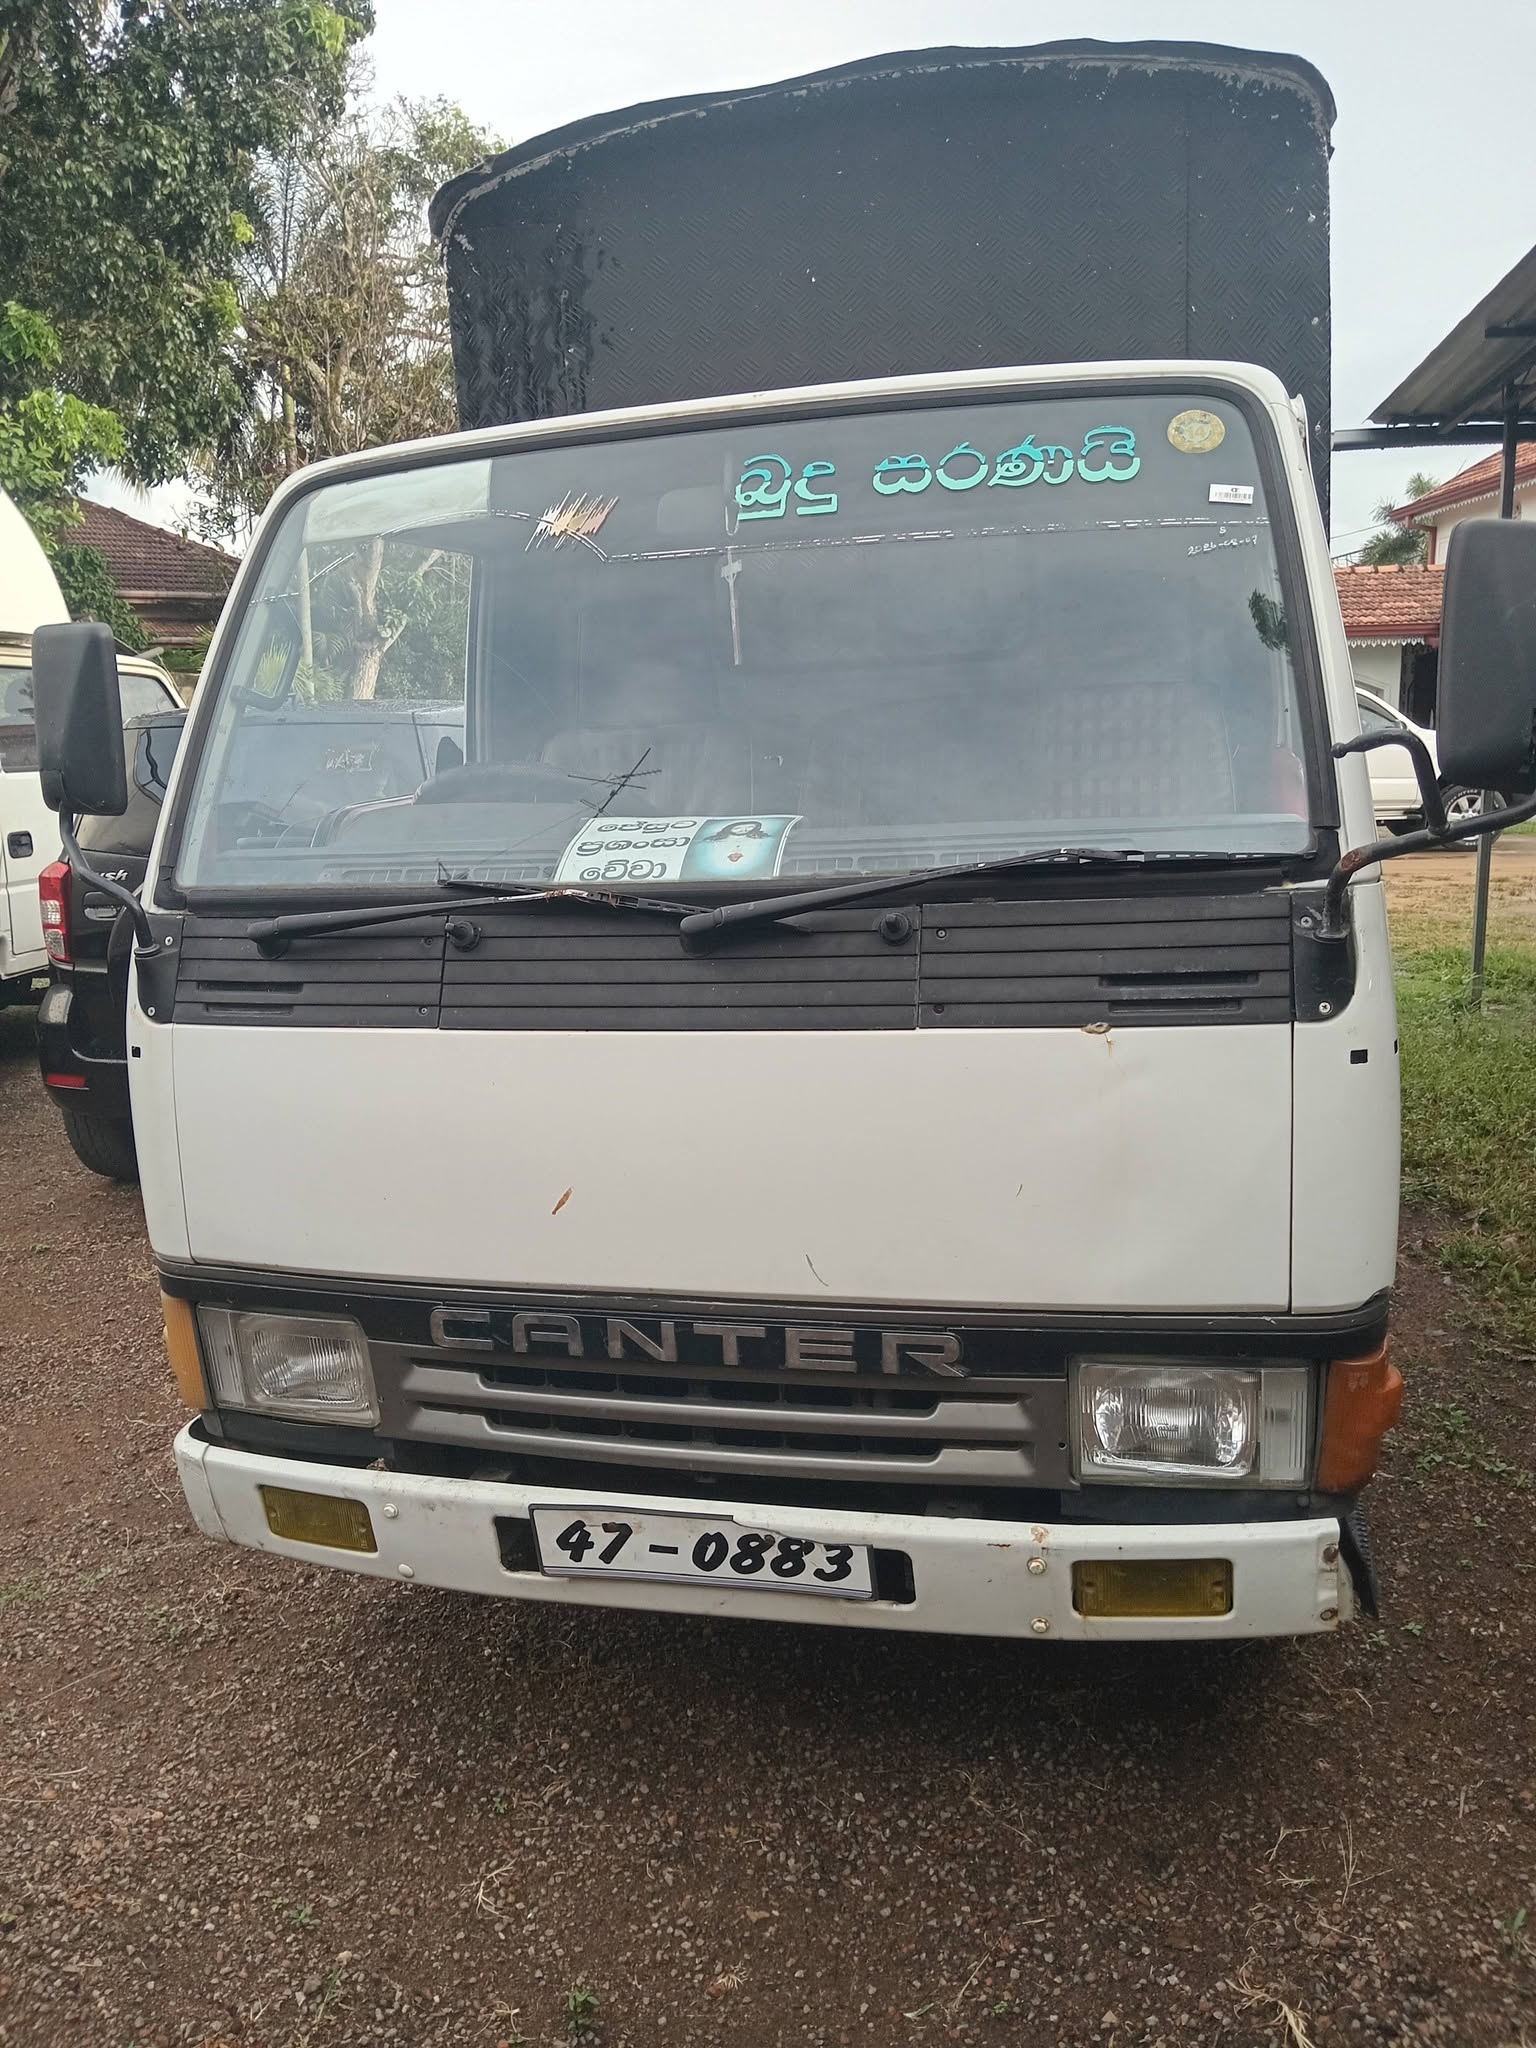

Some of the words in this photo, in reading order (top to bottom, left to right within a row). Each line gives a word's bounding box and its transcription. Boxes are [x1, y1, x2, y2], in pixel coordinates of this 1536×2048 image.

[735, 453, 838, 520] බුදු
[872, 425, 1141, 495] සරණයි
[579, 860, 667, 881] වේවා
[429, 1306, 970, 1378] CANTER
